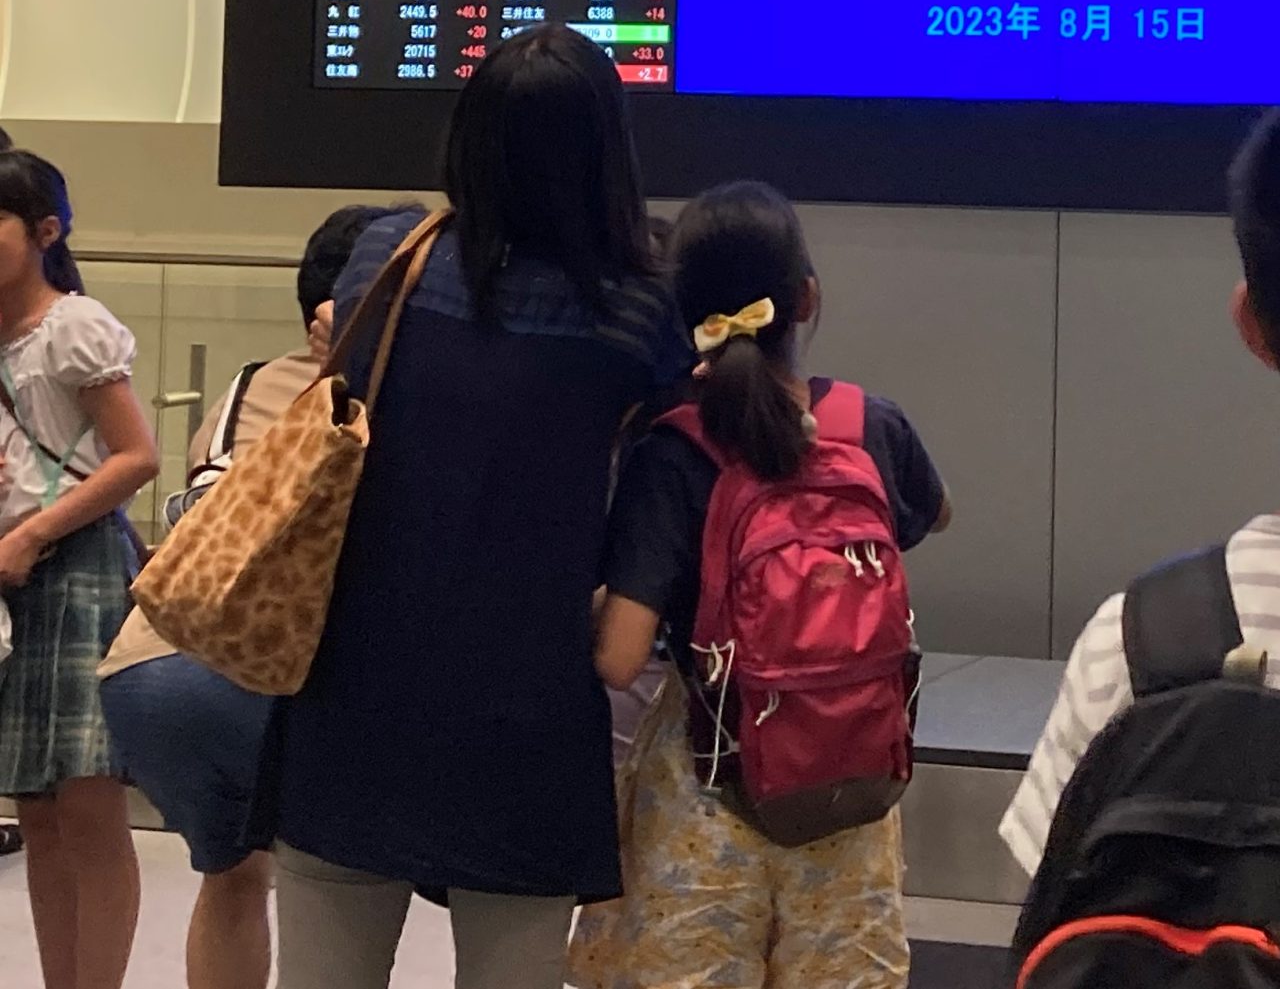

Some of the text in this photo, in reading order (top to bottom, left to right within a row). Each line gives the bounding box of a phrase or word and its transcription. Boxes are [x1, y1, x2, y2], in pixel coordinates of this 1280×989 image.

[926, 2, 1204, 42] 2023年 8月 15日
